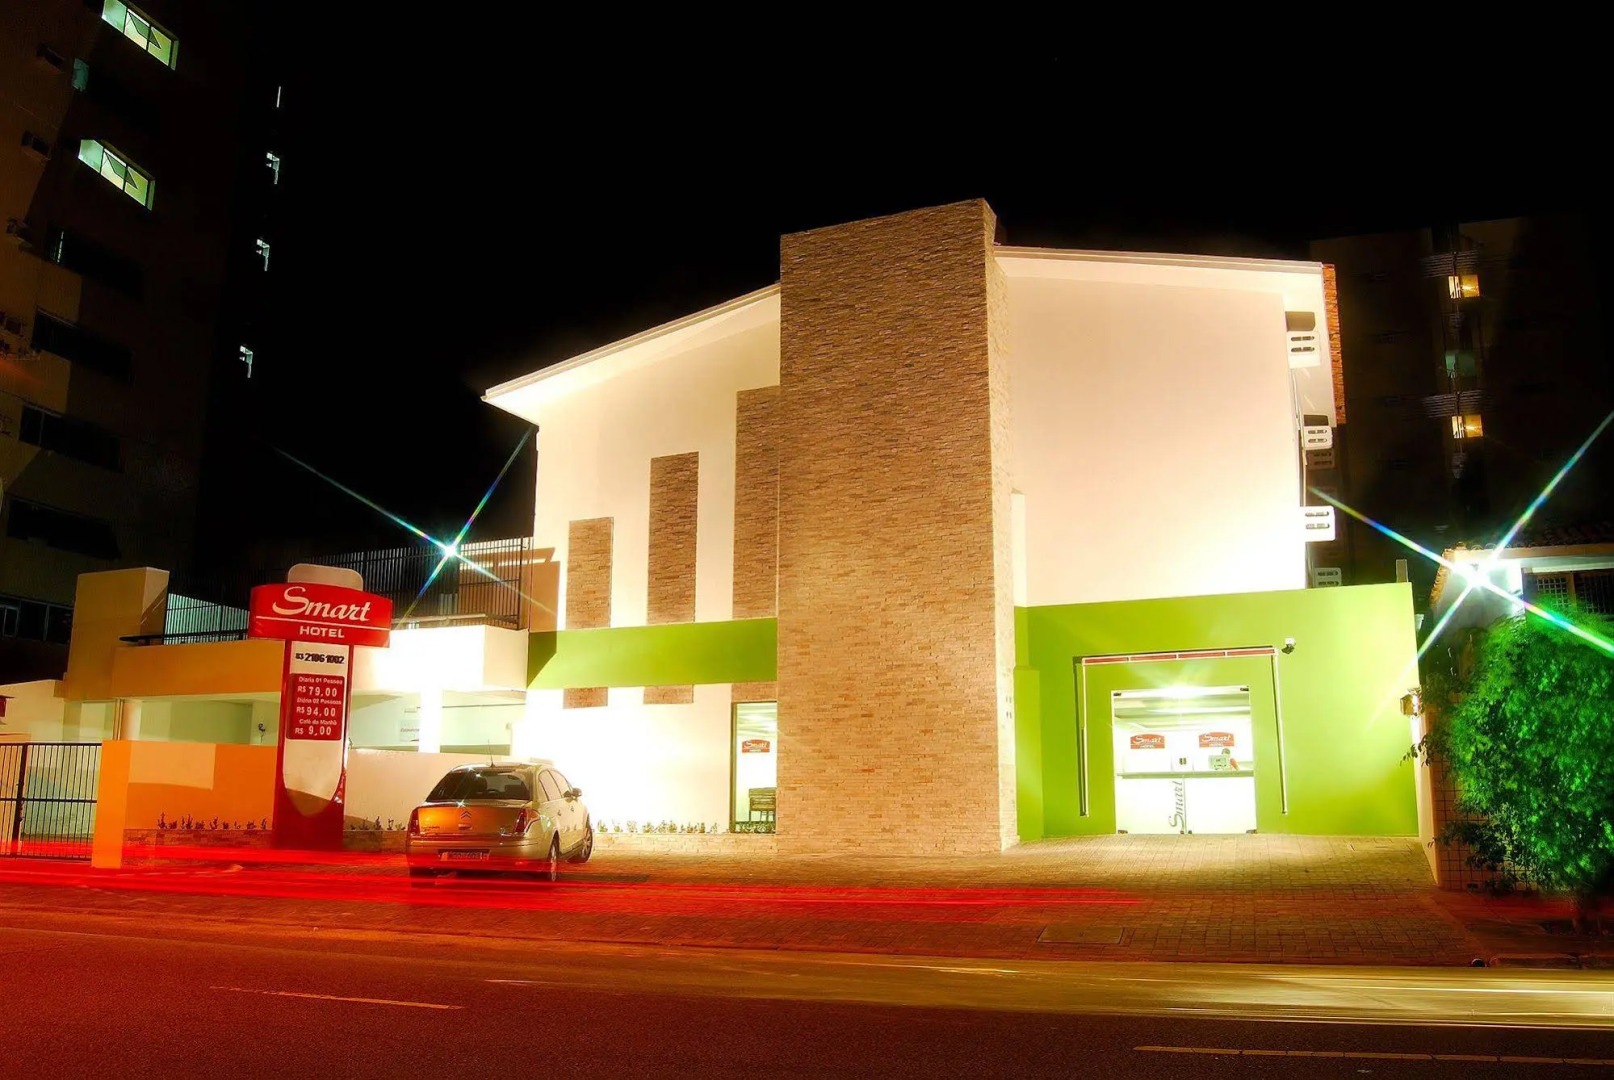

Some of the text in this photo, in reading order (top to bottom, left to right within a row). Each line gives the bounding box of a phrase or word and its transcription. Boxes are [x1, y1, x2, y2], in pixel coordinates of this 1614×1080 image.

[272, 586, 371, 621] Smart
[300, 626, 345, 638] HOTEL
[297, 685, 306, 693] R$
[296, 706, 305, 714] R$
[294, 727, 304, 735] R$
